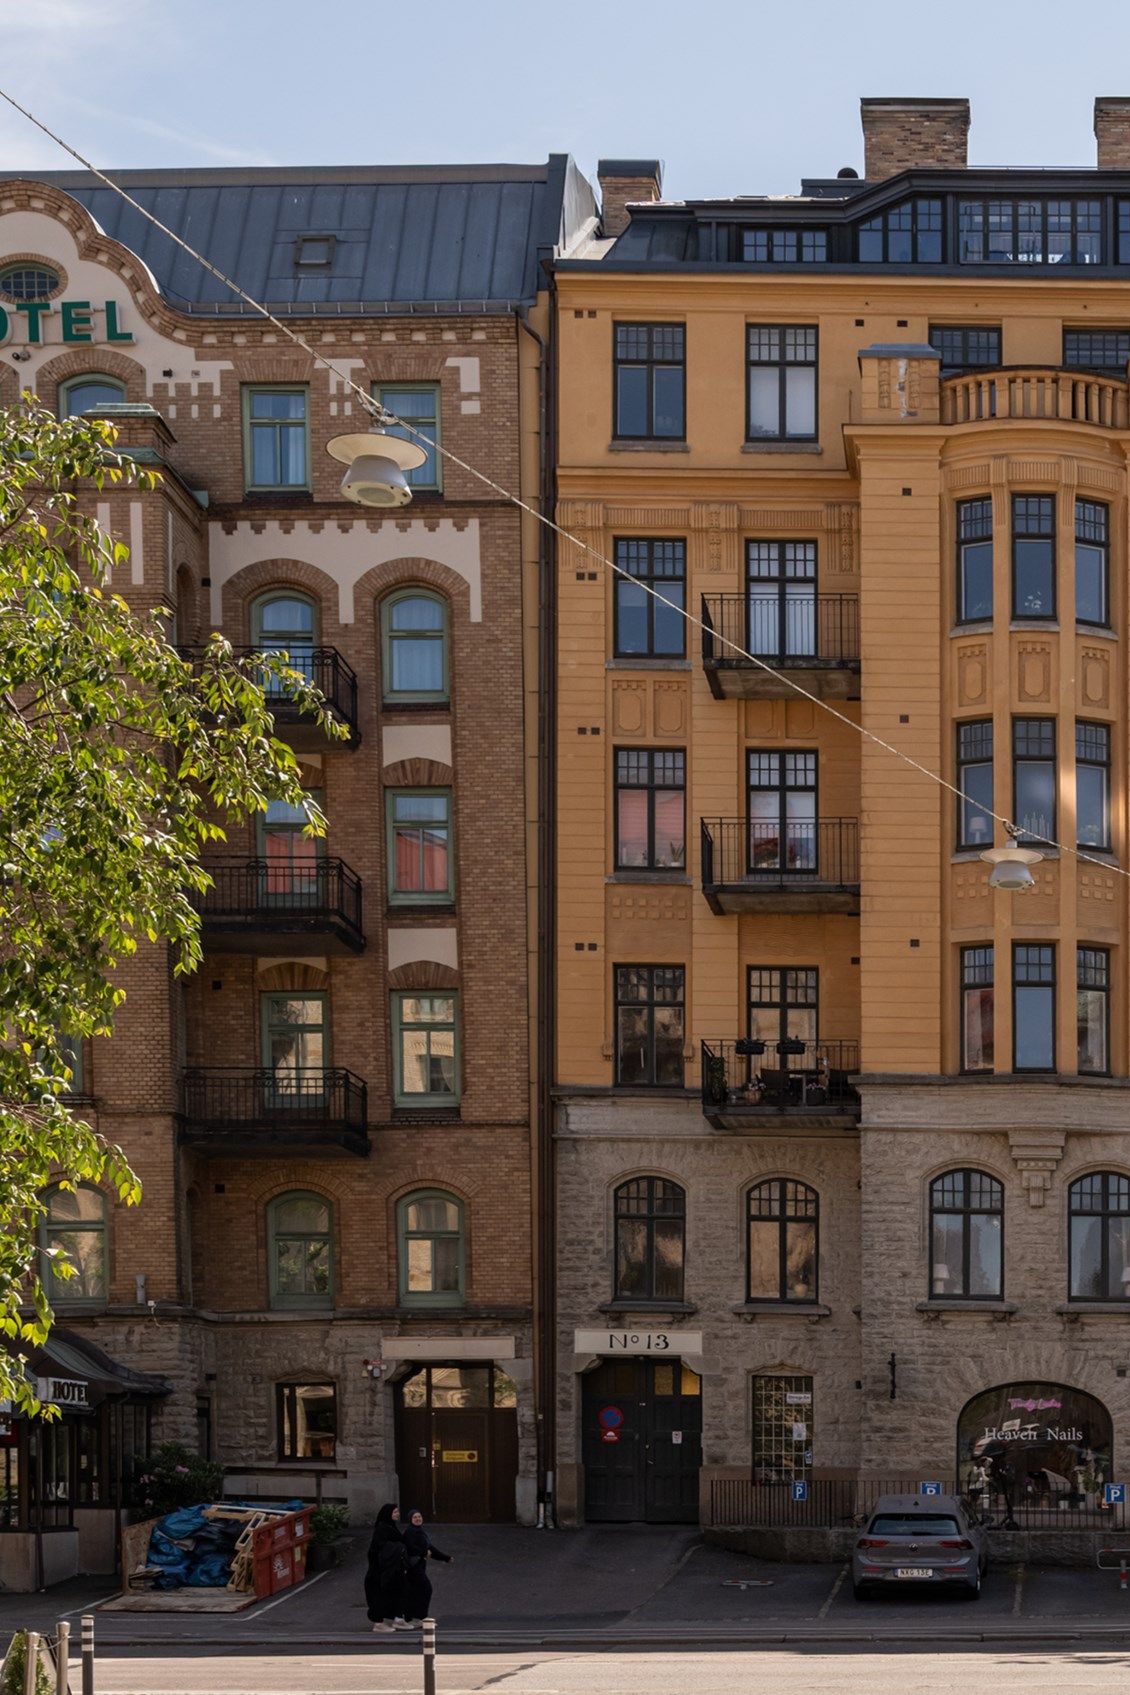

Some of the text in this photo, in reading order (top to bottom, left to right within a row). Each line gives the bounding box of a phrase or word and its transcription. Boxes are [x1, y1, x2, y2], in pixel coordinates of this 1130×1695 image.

[0, 301, 135, 343] TEL
[647, 1334, 669, 1349] 13
[984, 1427, 1083, 1440] Heaven Nails
[796, 1486, 803, 1499] P
[1111, 1489, 1120, 1501] P
